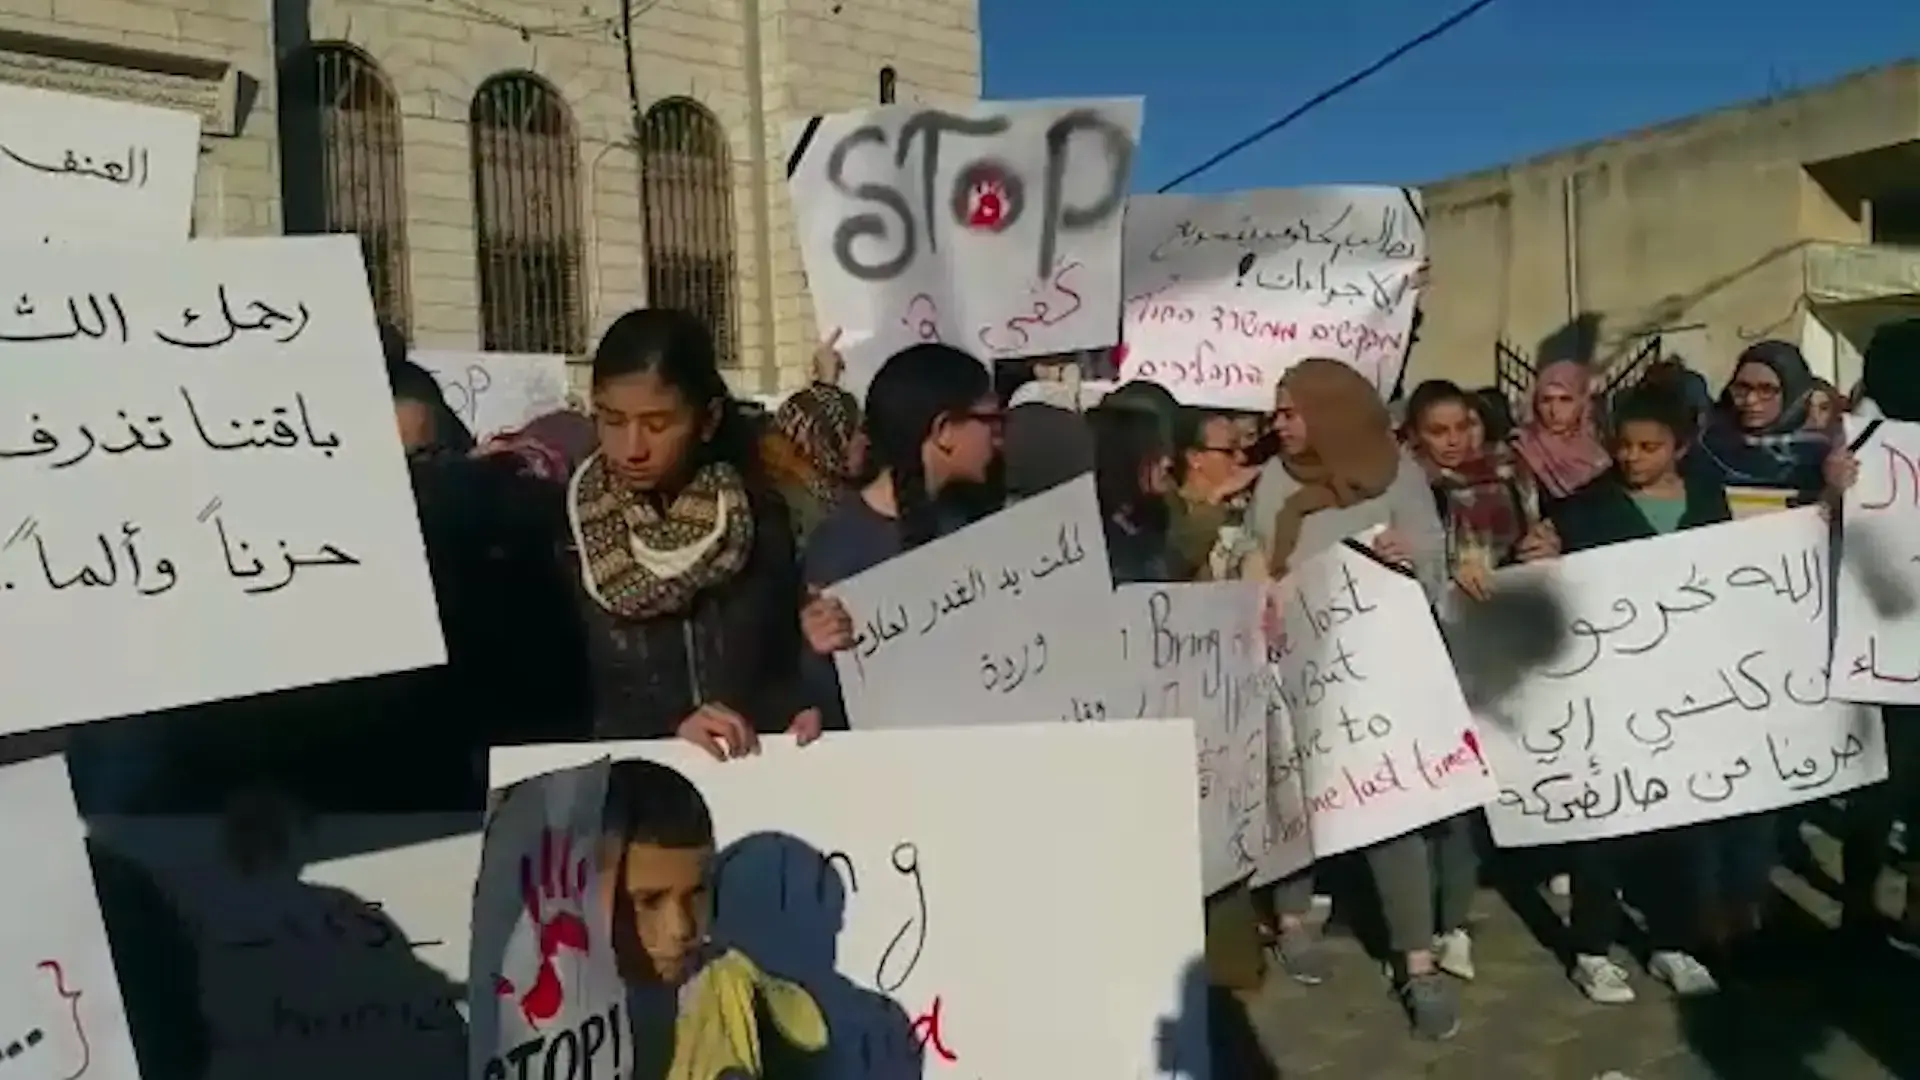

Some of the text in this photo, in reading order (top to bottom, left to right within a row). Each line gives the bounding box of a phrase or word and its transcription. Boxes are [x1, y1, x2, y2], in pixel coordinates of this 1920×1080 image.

[827, 108, 1133, 280] STOP
[1301, 563, 1377, 642] lost
[1726, 548, 1824, 621] الله
[1785, 667, 1831, 705] ن
[1338, 706, 1392, 745] to
[1346, 751, 1406, 806] last
